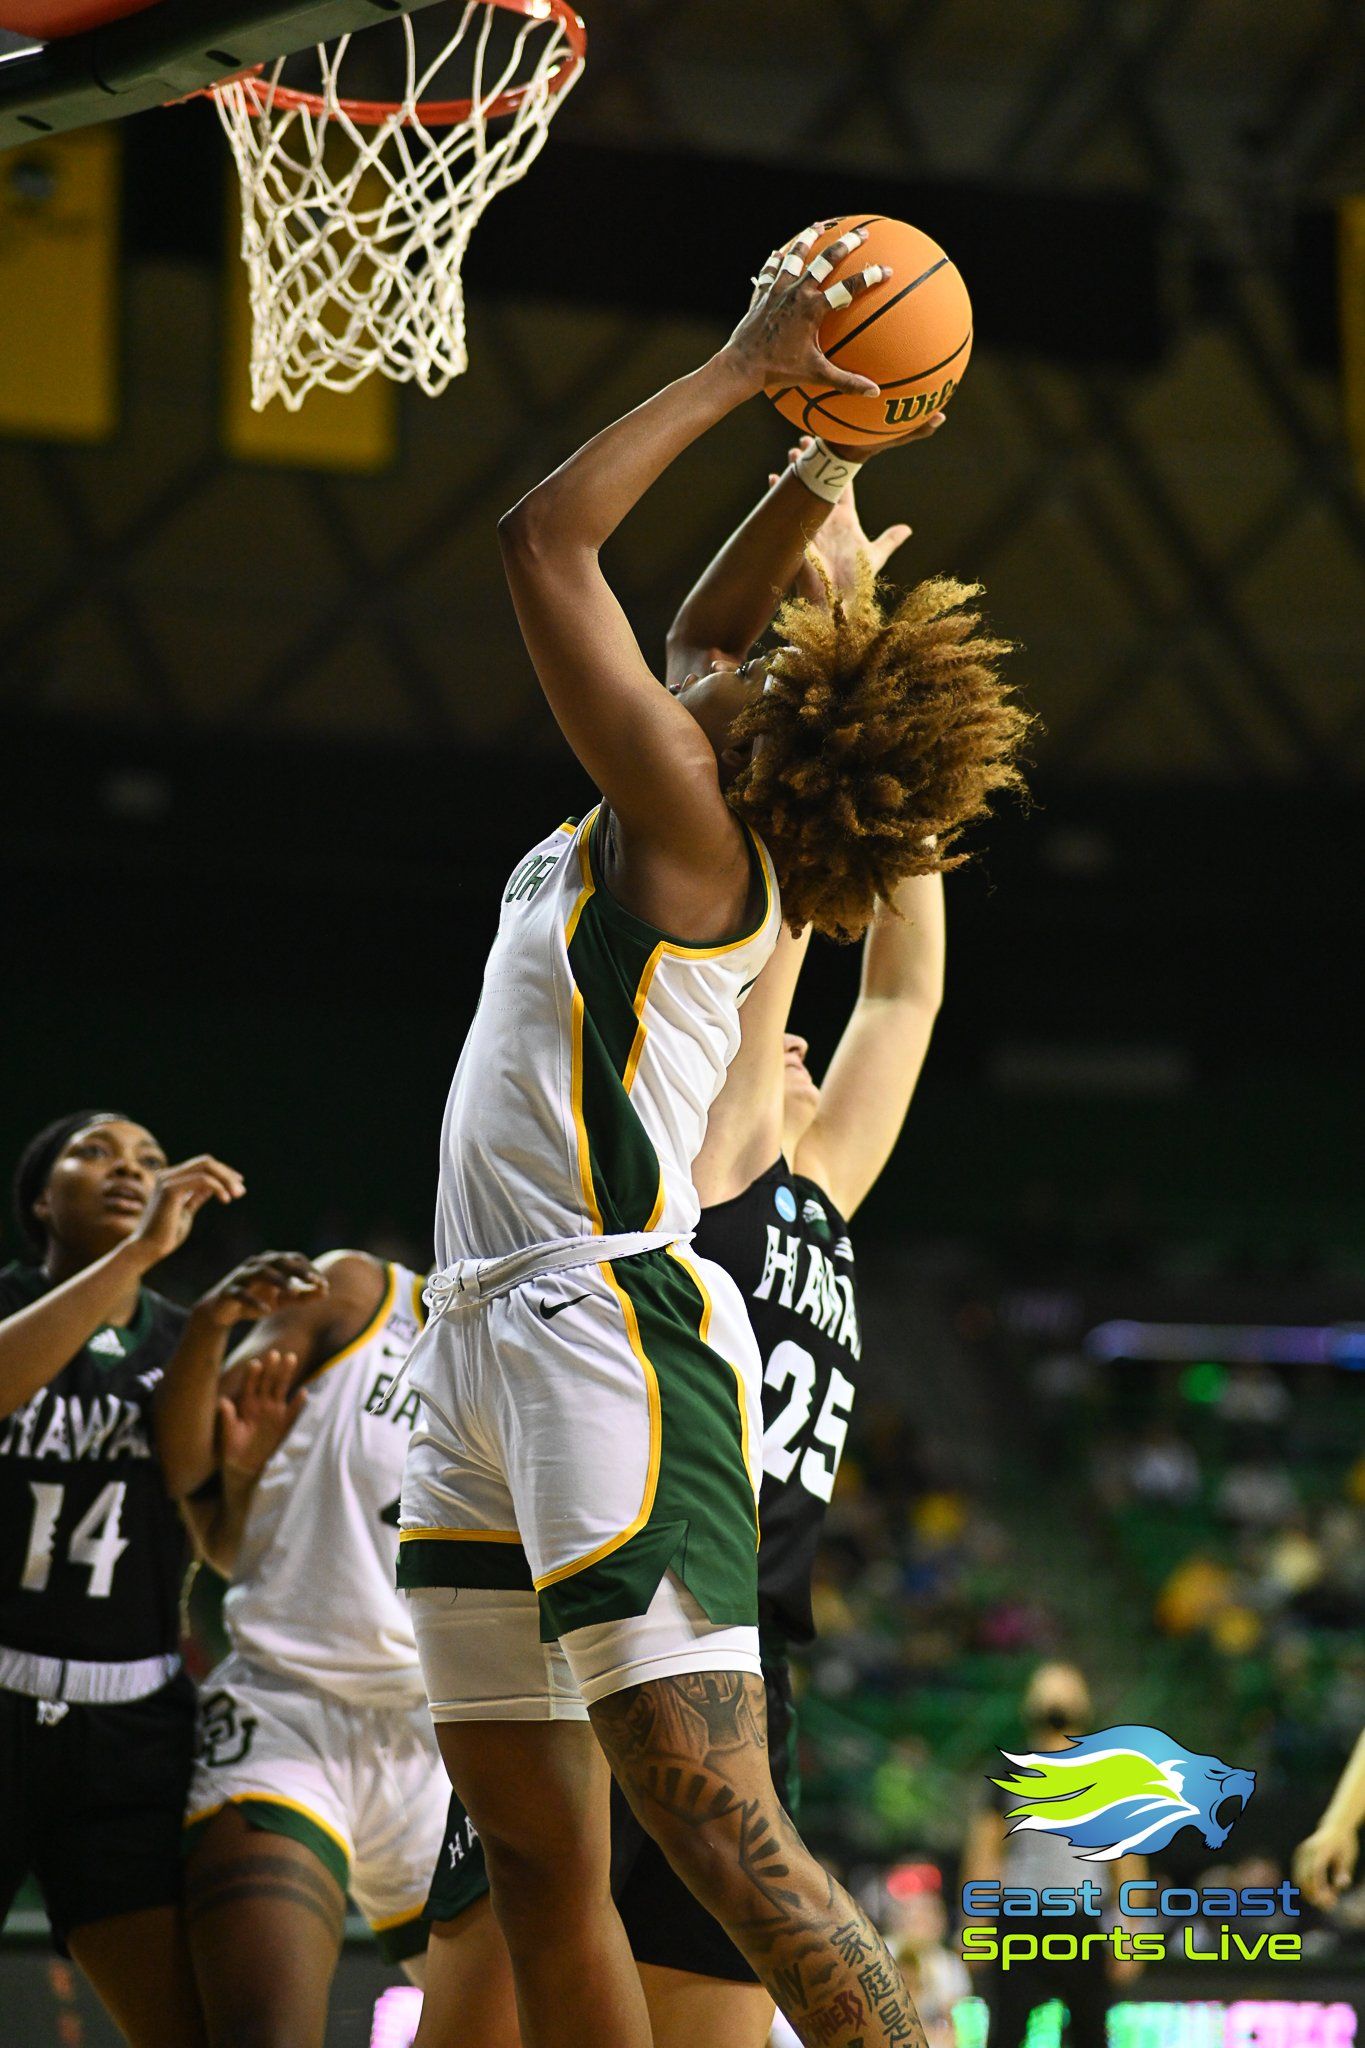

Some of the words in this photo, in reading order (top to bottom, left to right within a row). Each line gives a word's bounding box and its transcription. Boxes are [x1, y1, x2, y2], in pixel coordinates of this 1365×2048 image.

[763, 1340, 855, 1504] 25
[20, 1481, 131, 1598] 14
[829, 1919, 919, 2048] 家庭是
